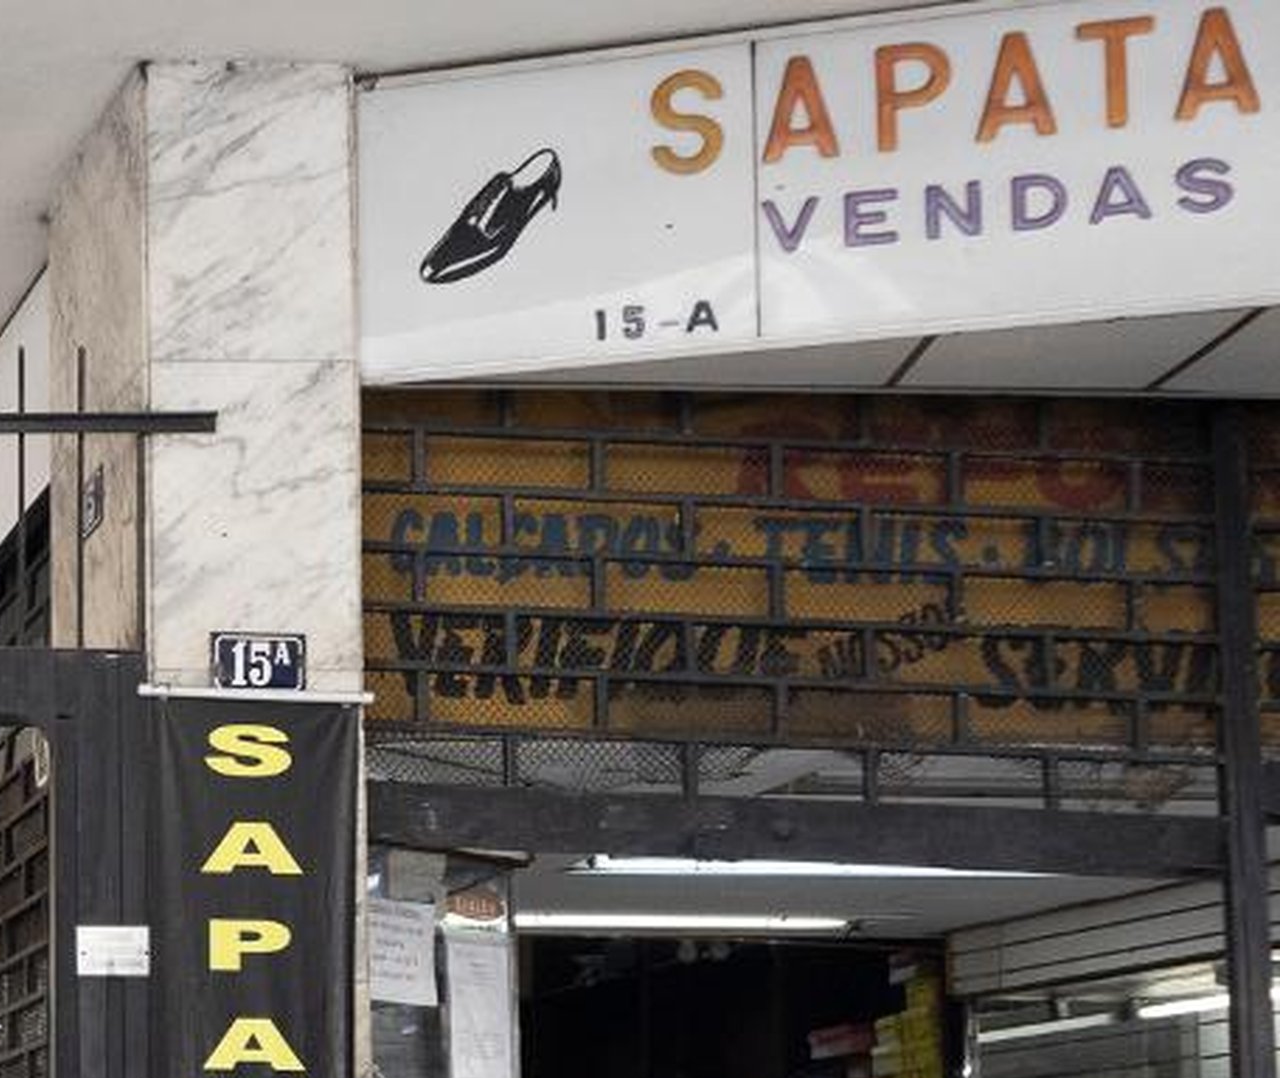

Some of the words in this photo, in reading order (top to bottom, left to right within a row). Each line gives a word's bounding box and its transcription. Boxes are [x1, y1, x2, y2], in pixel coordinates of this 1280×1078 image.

[648, 5, 1261, 175] SAPATA
[761, 158, 1236, 254] VENDAS
[594, 299, 720, 341] 15-A
